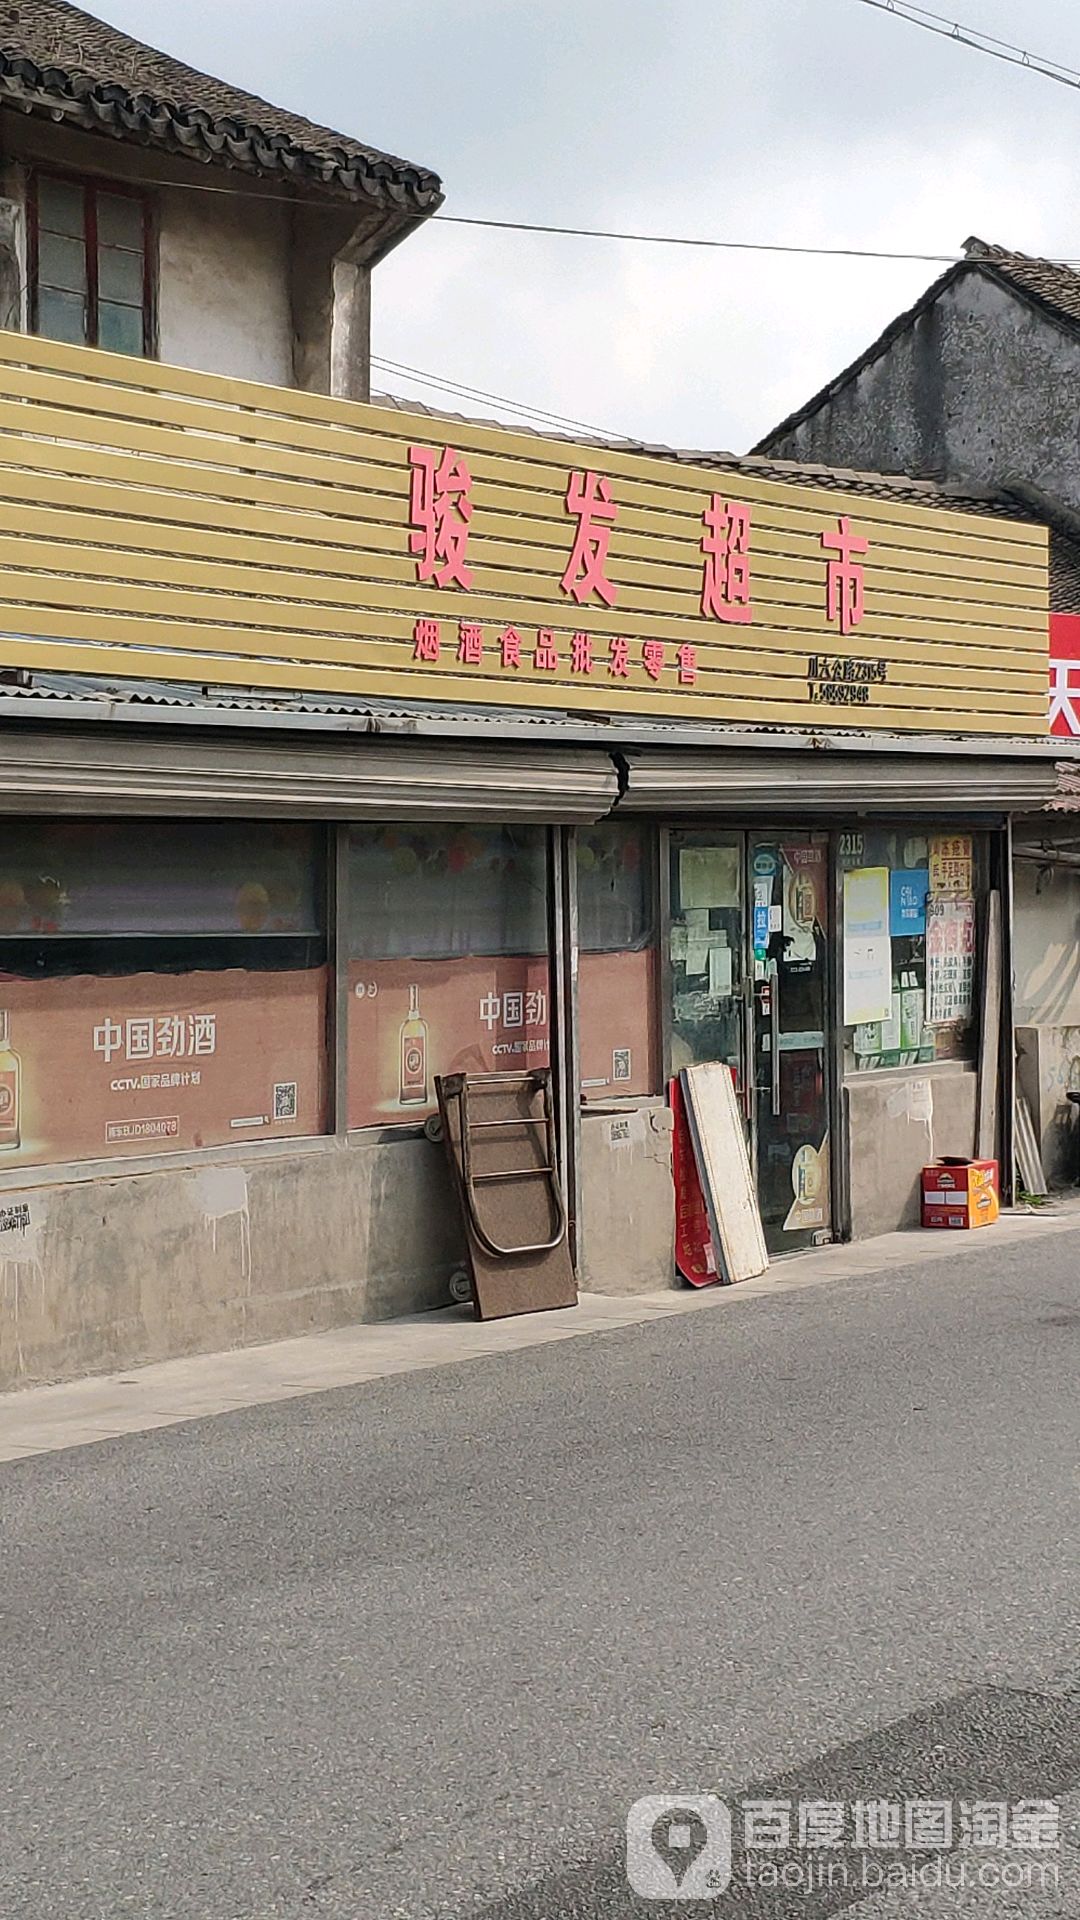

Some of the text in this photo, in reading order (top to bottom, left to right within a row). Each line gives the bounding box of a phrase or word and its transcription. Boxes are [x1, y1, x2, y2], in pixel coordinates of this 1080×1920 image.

[408, 446, 868, 634] 骏发超市
[413, 619, 698, 685] 烟酒食品批发零售
[839, 833, 864, 855] 2315
[480, 989, 547, 1030] 中国劲
[94, 1015, 216, 1063] 中国劲酒
